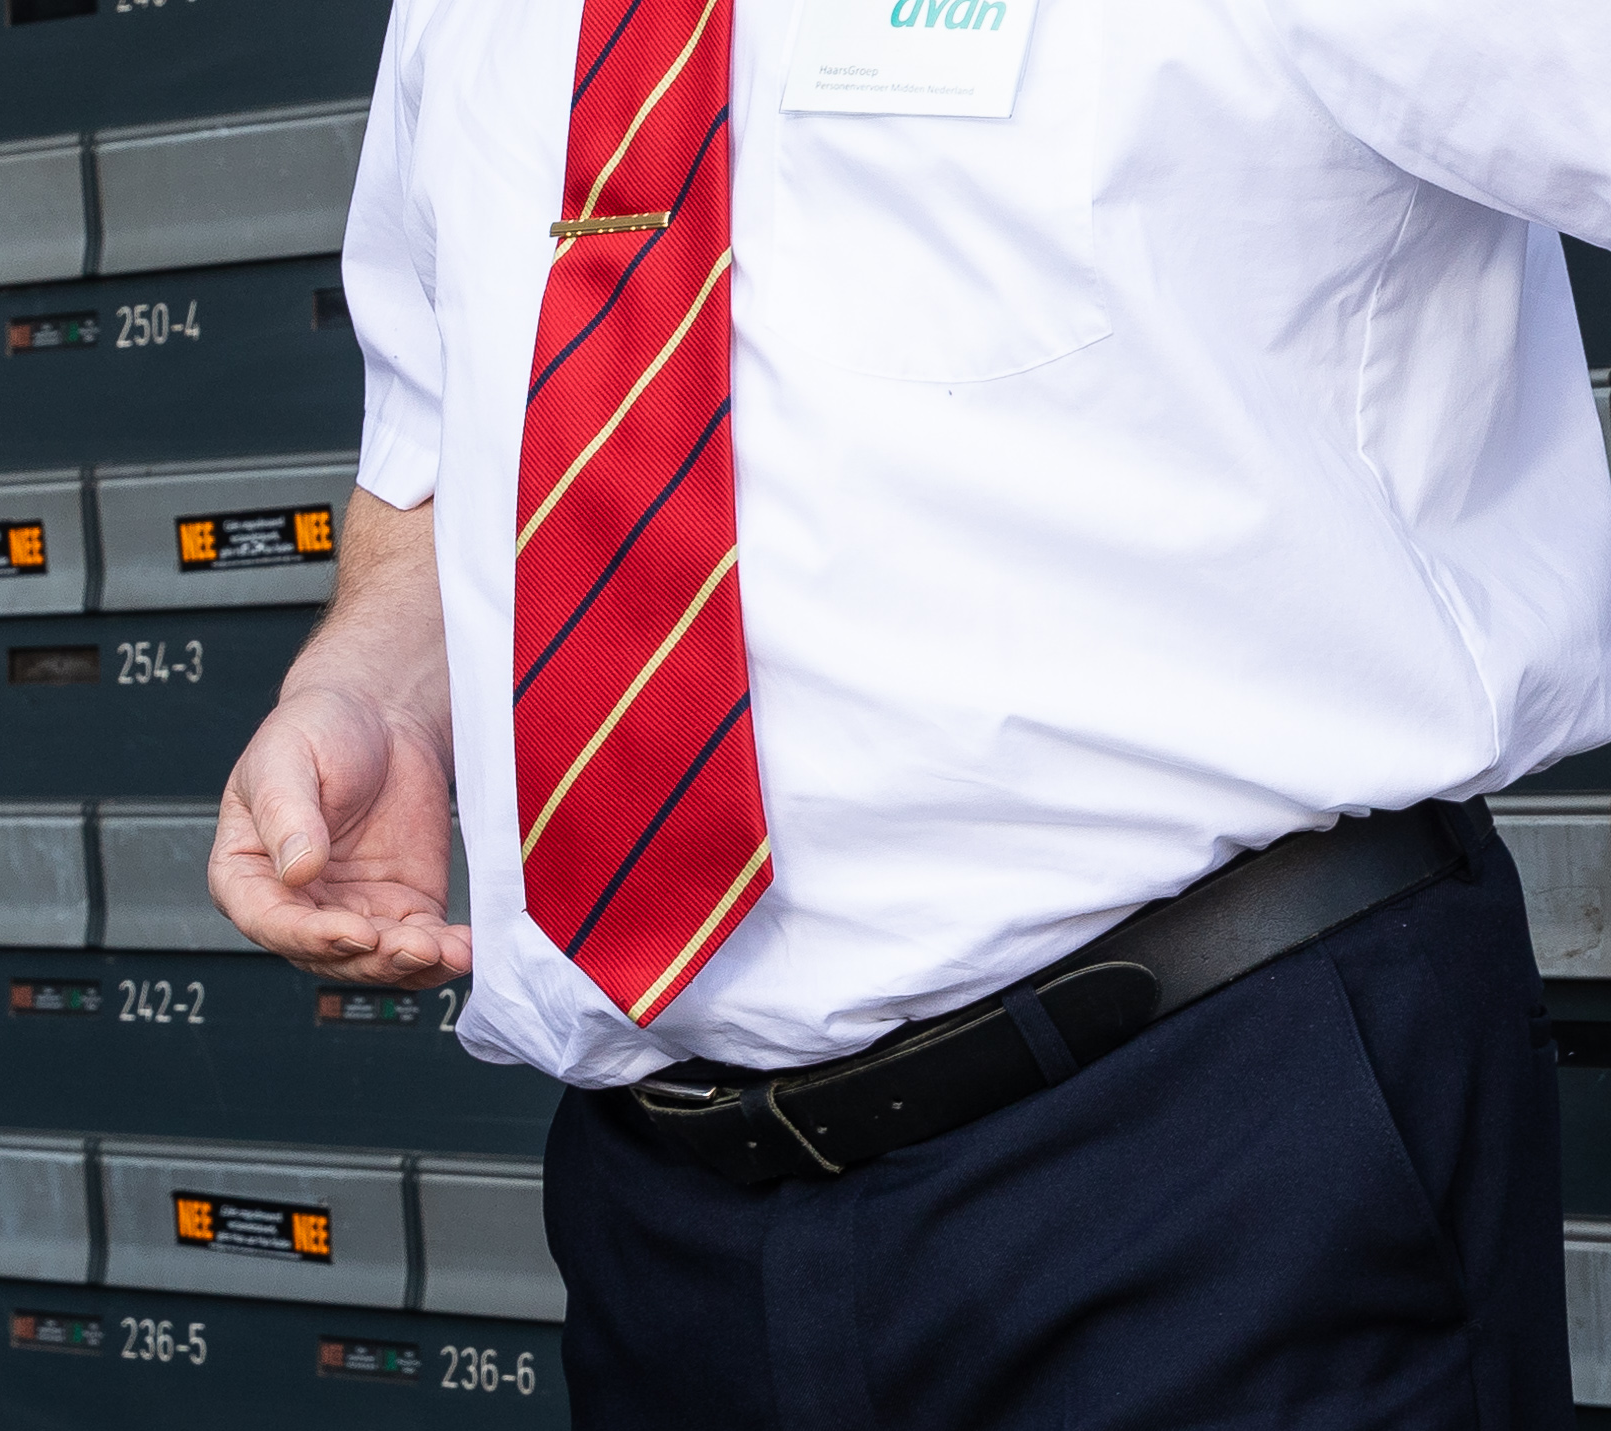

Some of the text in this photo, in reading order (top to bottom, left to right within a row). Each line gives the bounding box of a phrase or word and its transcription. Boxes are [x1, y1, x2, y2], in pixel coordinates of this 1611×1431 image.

[815, 81, 975, 96] Personenvervoer Midden Nederland
[819, 65, 879, 78] HaarsGroep
[115, 301, 201, 349] 250-4
[117, 640, 203, 685] 254-3
[119, 979, 205, 1024] 242-2
[120, 1316, 207, 1365] 236-5
[440, 1345, 536, 1395] 236-6
